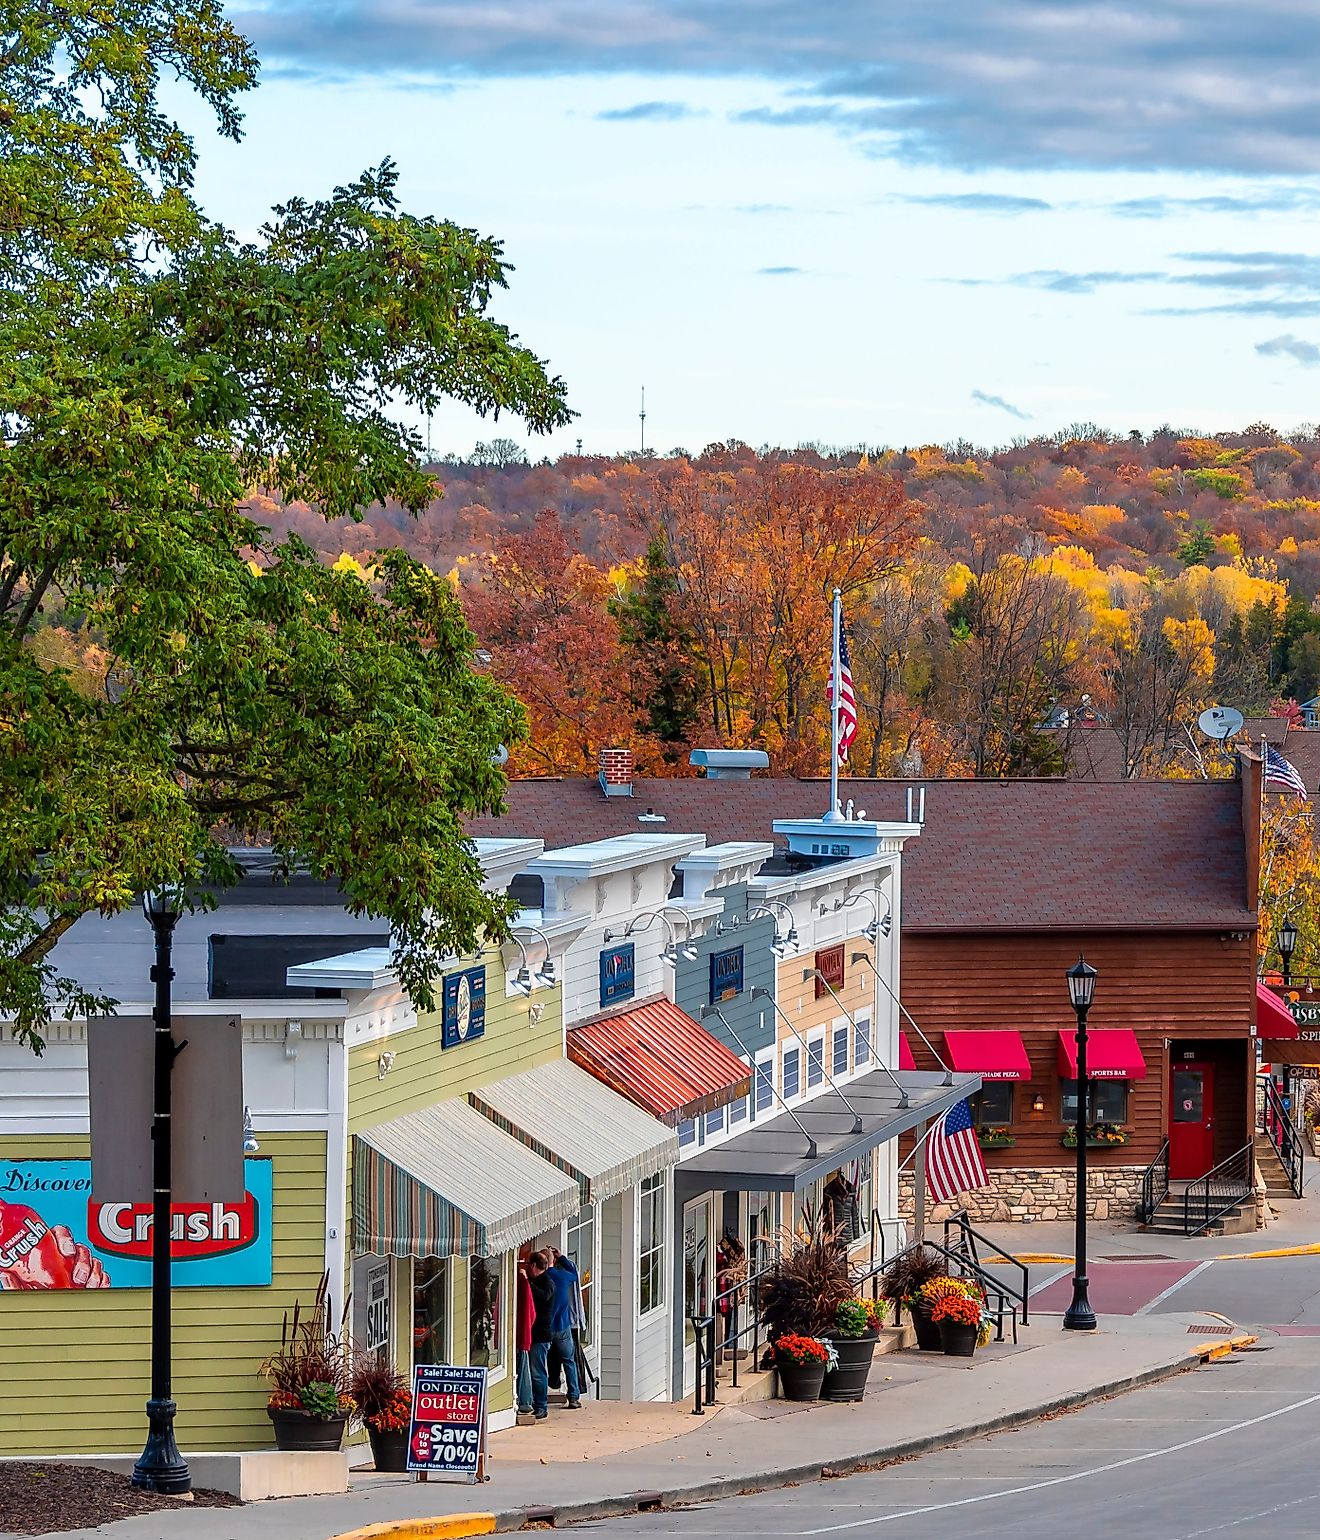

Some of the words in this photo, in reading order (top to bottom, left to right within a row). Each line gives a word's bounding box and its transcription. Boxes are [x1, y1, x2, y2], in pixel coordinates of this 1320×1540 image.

[1289, 1067, 1319, 1078] OPEN
[0, 1168, 91, 1192] Discover
[98, 1202, 241, 1244] Crush
[4, 1228, 27, 1249] ORANGE
[367, 1298, 389, 1349] SALE
[424, 1368, 443, 1377] Sale!
[444, 1369, 463, 1378] Sale!
[465, 1370, 484, 1379] Sale!
[421, 1383, 440, 1392] ON
[443, 1383, 477, 1394] DECK
[420, 1394, 476, 1410] outlet
[446, 1412, 474, 1421] store
[418, 1431, 430, 1441] Up
[430, 1424, 478, 1444] Save
[419, 1440, 428, 1448] to
[432, 1445, 476, 1463] 70%
